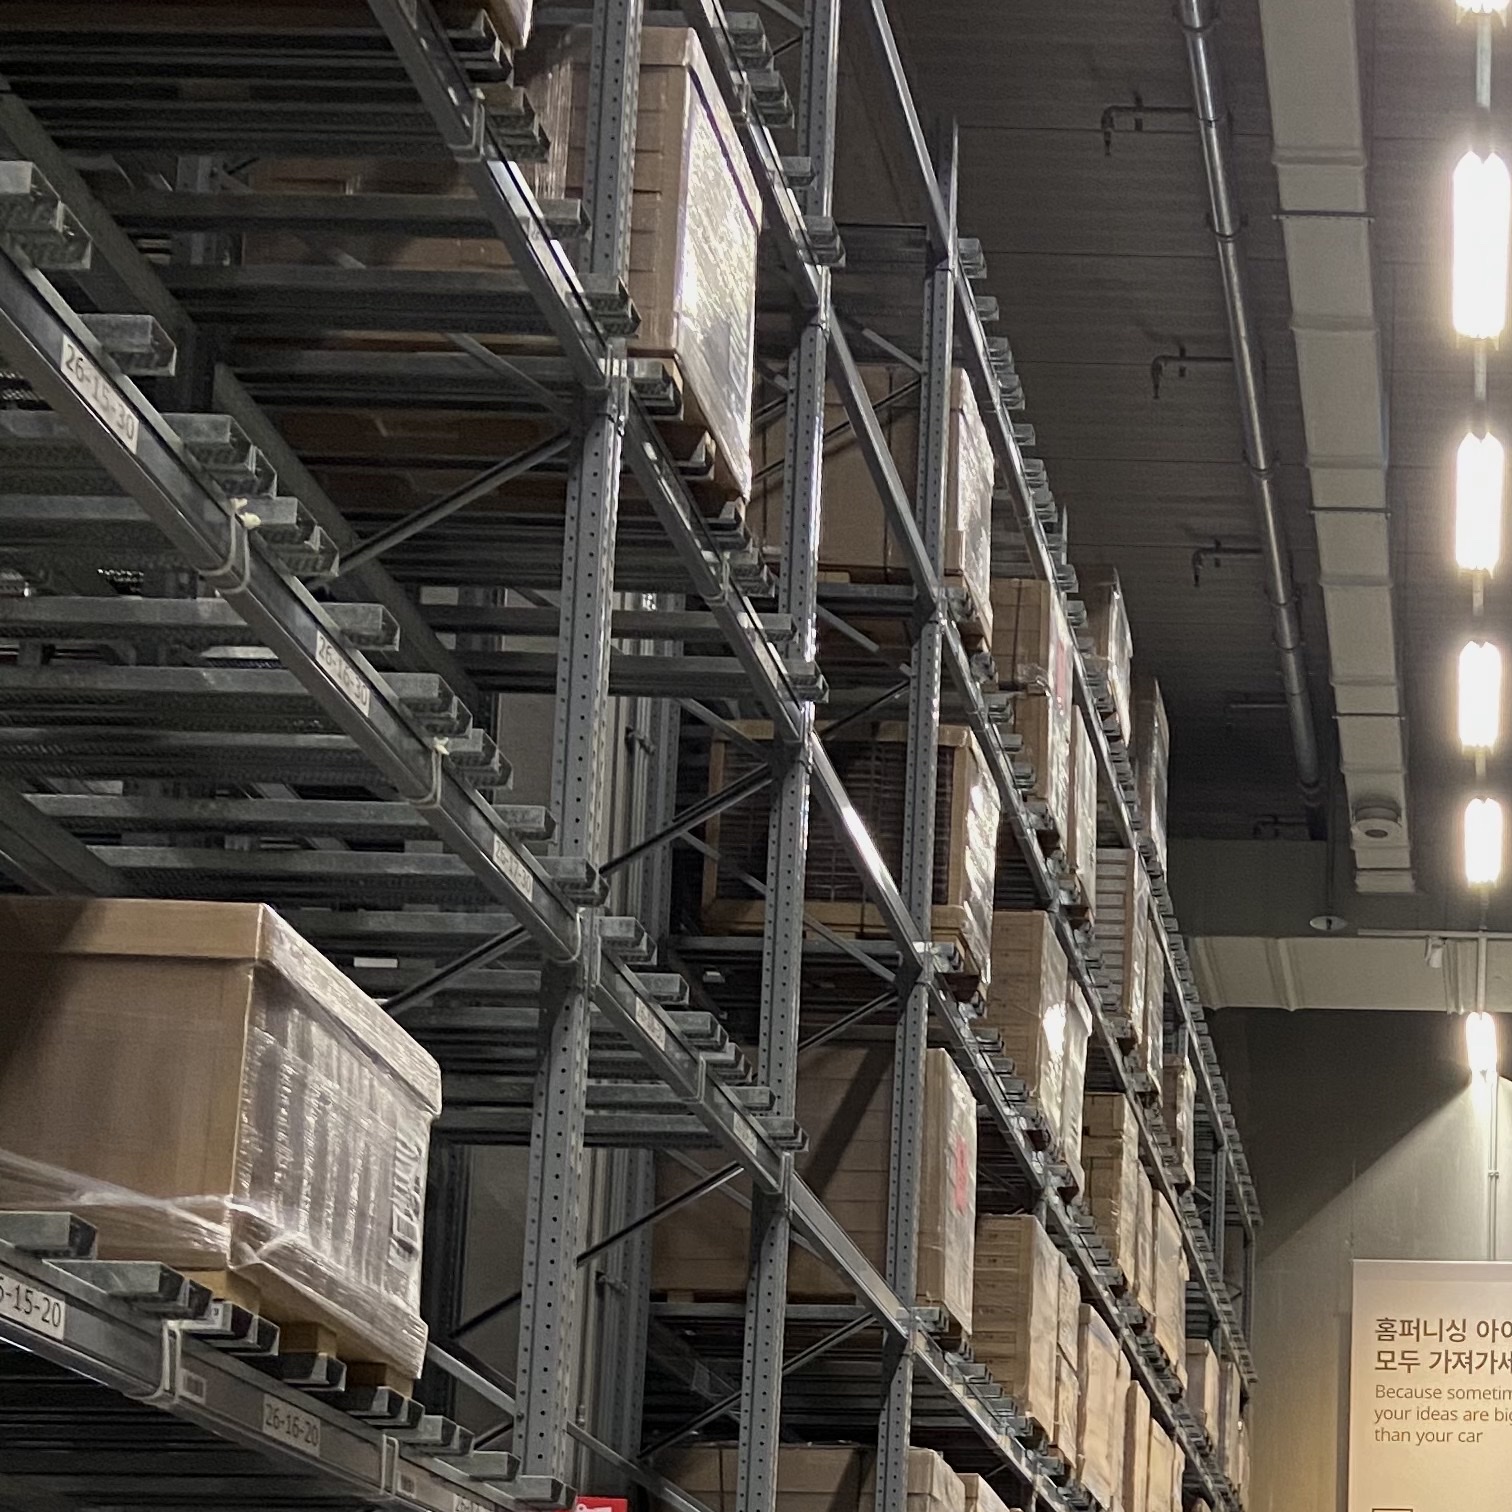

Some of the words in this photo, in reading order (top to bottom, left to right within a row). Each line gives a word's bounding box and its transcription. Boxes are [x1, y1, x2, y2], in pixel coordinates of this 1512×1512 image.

[64, 343, 135, 441] 26-15-30
[1375, 1317, 1467, 1343] 홈퍼니싱
[1374, 1349, 1421, 1374] 모두
[1375, 1383, 1442, 1399] Because
[265, 1402, 319, 1448] 26-16-20
[1374, 1408, 1411, 1424] your
[1416, 1405, 1458, 1421] ideas
[1463, 1409, 1489, 1421] are
[1374, 1427, 1411, 1442] than
[1416, 1430, 1453, 1446] your
[1458, 1430, 1483, 1443] car
